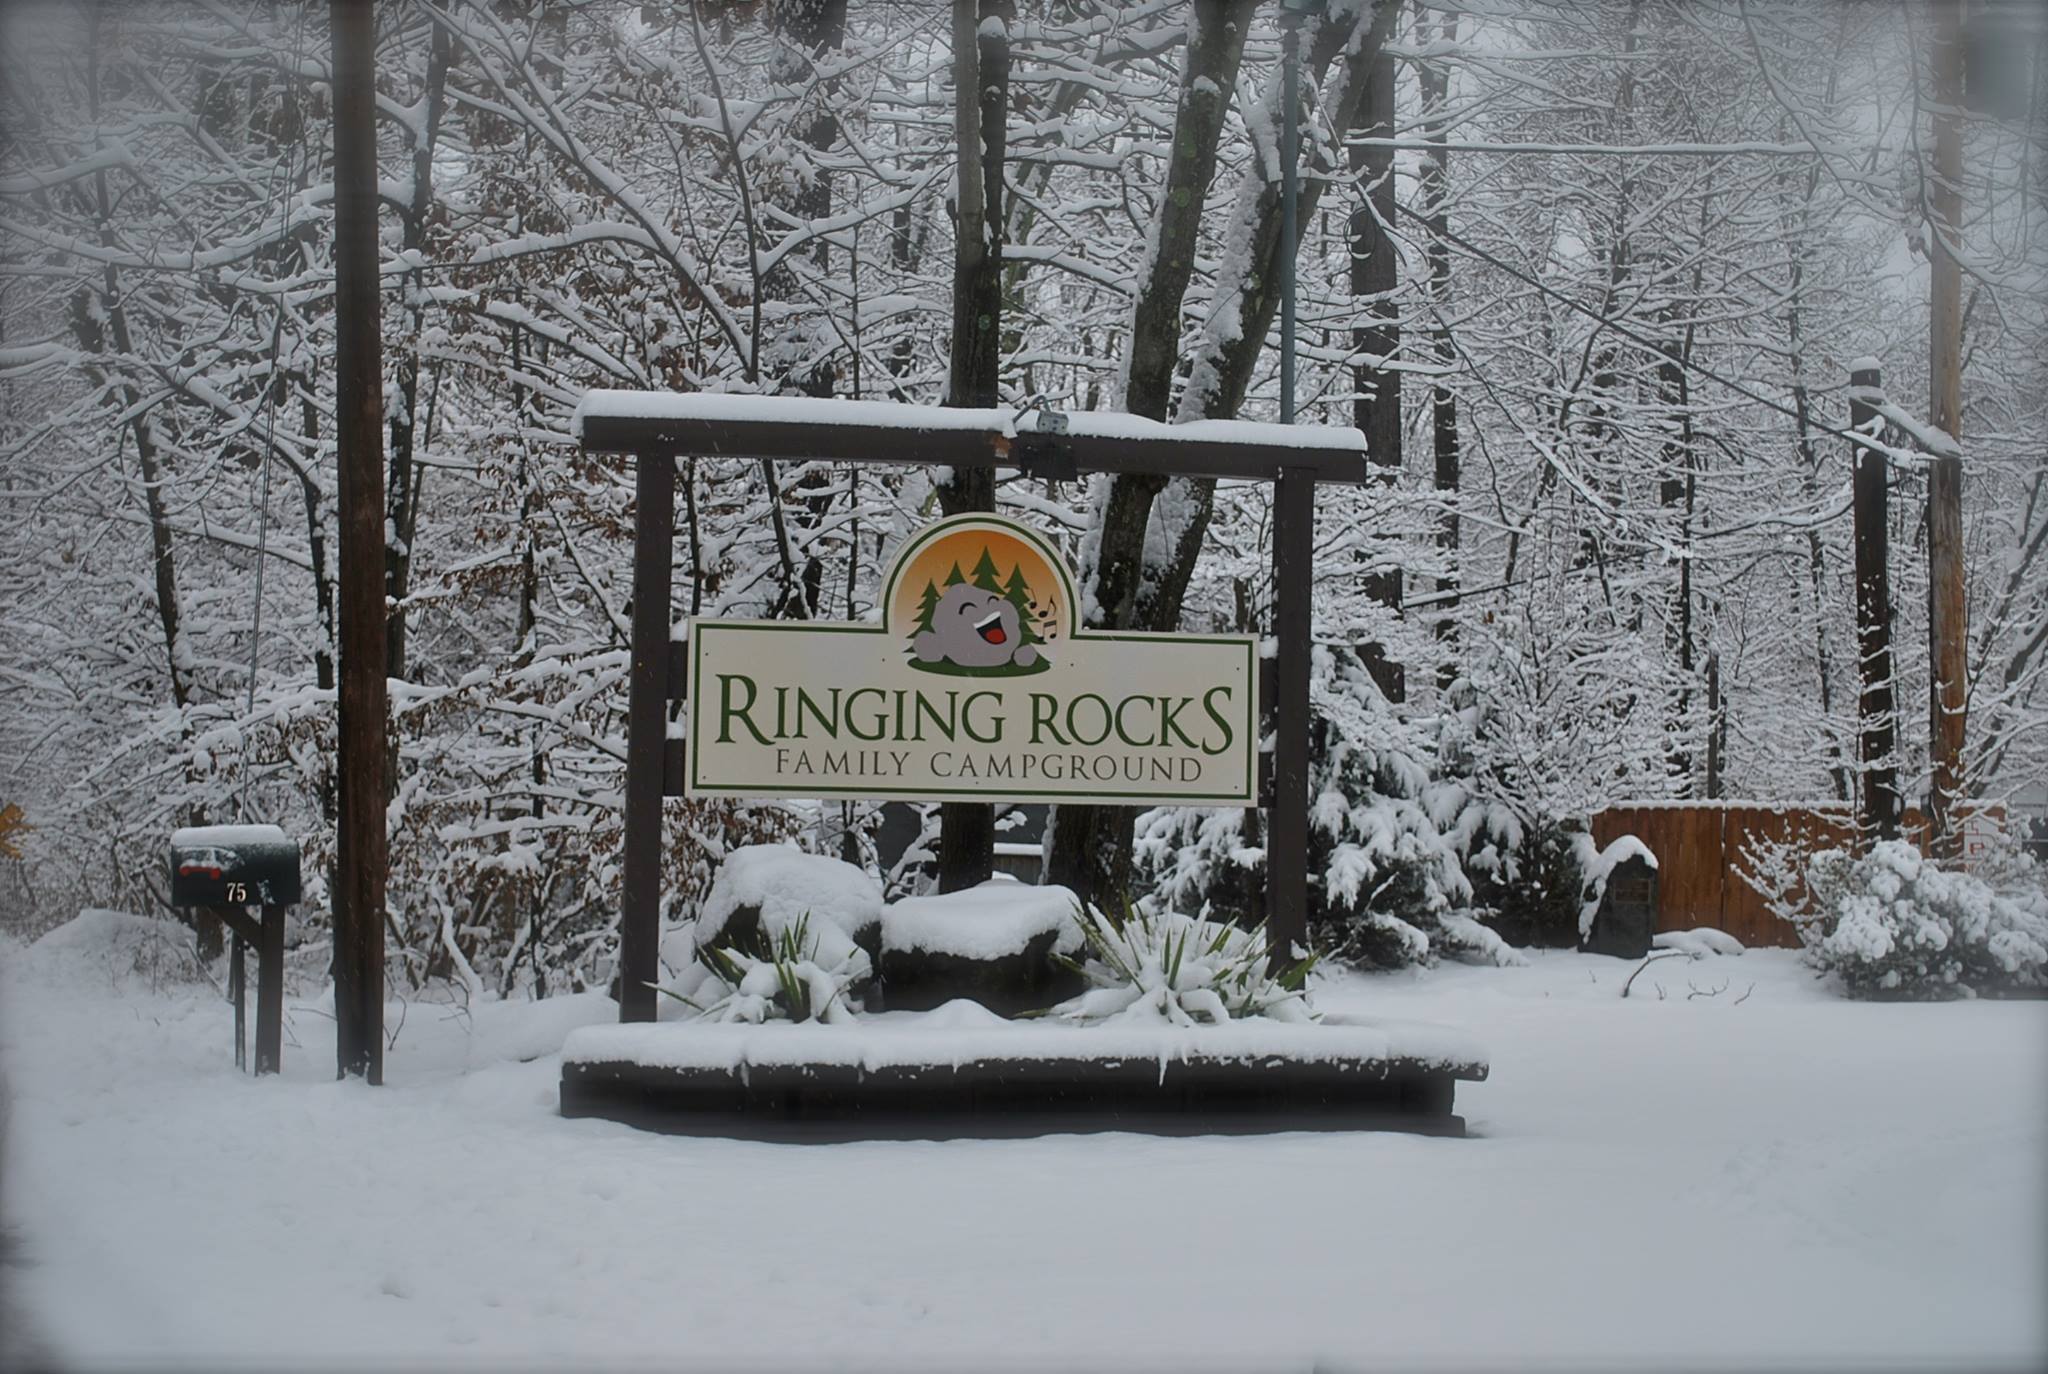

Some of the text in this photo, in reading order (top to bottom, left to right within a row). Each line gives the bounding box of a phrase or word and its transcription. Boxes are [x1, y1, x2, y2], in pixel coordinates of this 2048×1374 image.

[714, 673, 1234, 756] RINGING ROCKS
[775, 748, 1203, 783] FAMILY CAMPGROUND
[227, 882, 247, 902] 75
